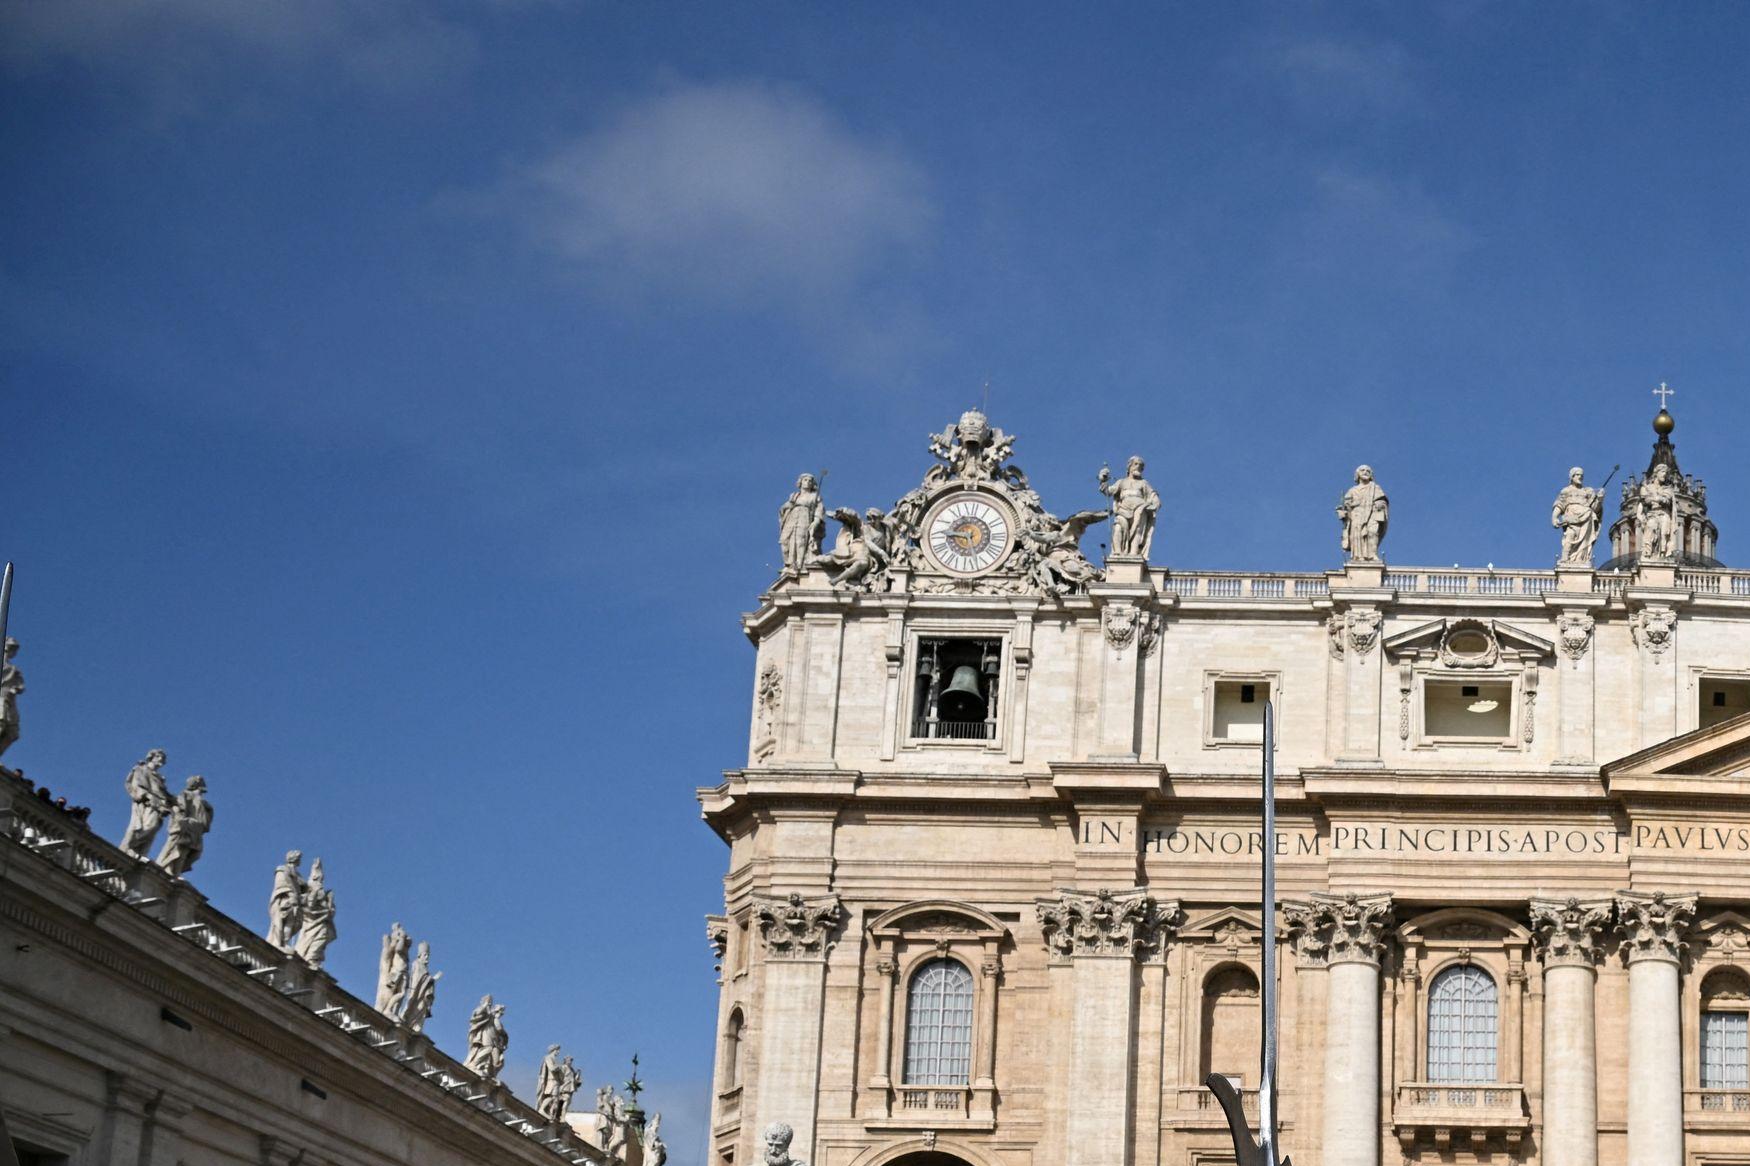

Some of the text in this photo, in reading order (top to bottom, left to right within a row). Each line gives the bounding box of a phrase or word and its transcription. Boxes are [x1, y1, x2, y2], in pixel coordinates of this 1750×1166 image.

[1082, 820, 1124, 844] IN
[1141, 829, 1321, 856] HONOREM
[1332, 826, 1512, 852] PRINCIPIS
[1518, 830, 1627, 854] APOST
[1634, 824, 1750, 852] PAVLVS
